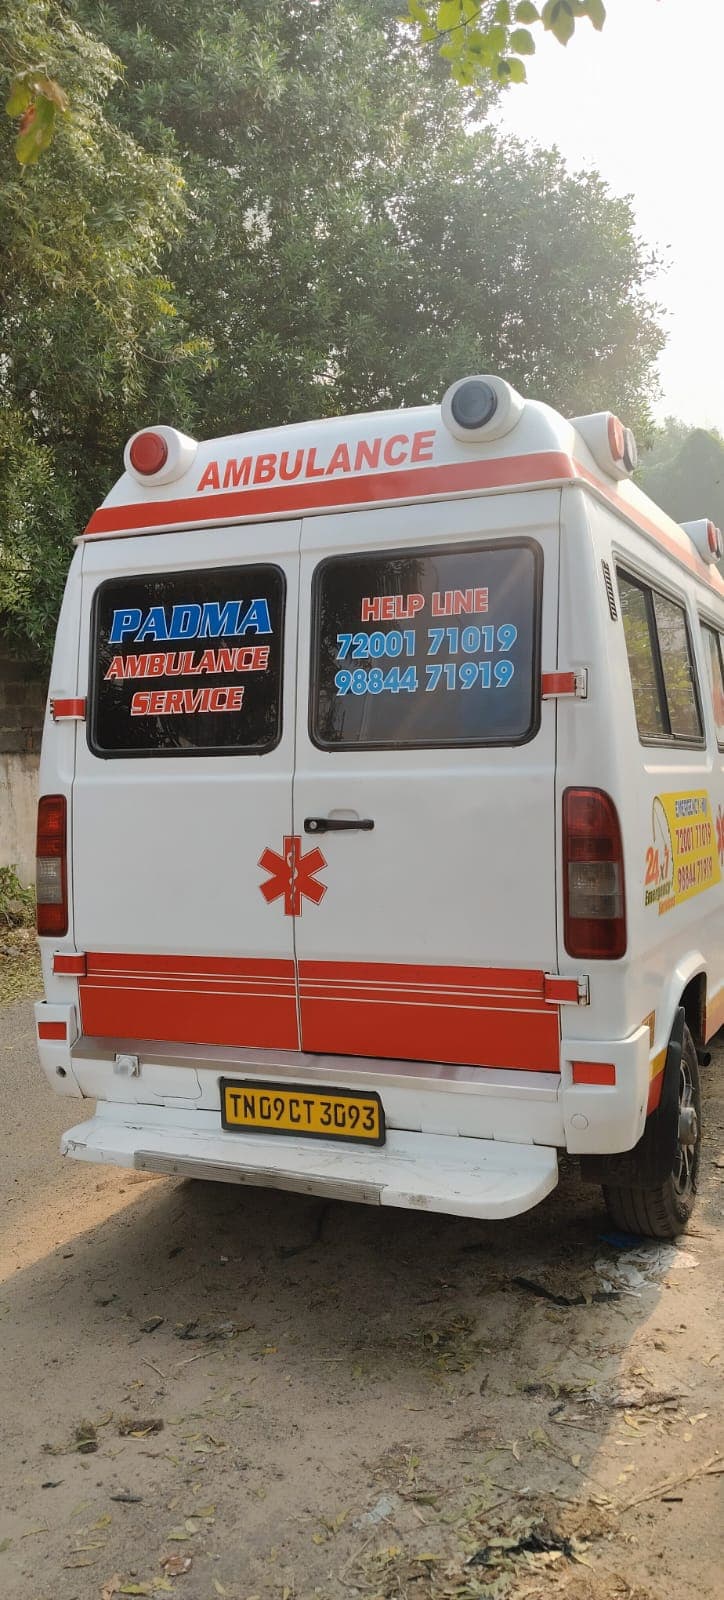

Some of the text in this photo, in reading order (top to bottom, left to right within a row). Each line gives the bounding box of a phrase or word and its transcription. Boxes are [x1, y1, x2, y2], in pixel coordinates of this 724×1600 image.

[197, 430, 436, 491] AMBULANCE
[108, 598, 273, 644] PADMA
[361, 587, 488, 622] HELP LINE
[336, 623, 518, 660] 72001 71019
[104, 645, 270, 680] AMBULANCE
[334, 660, 515, 696] 98844 71919
[130, 686, 244, 716] SERVICE
